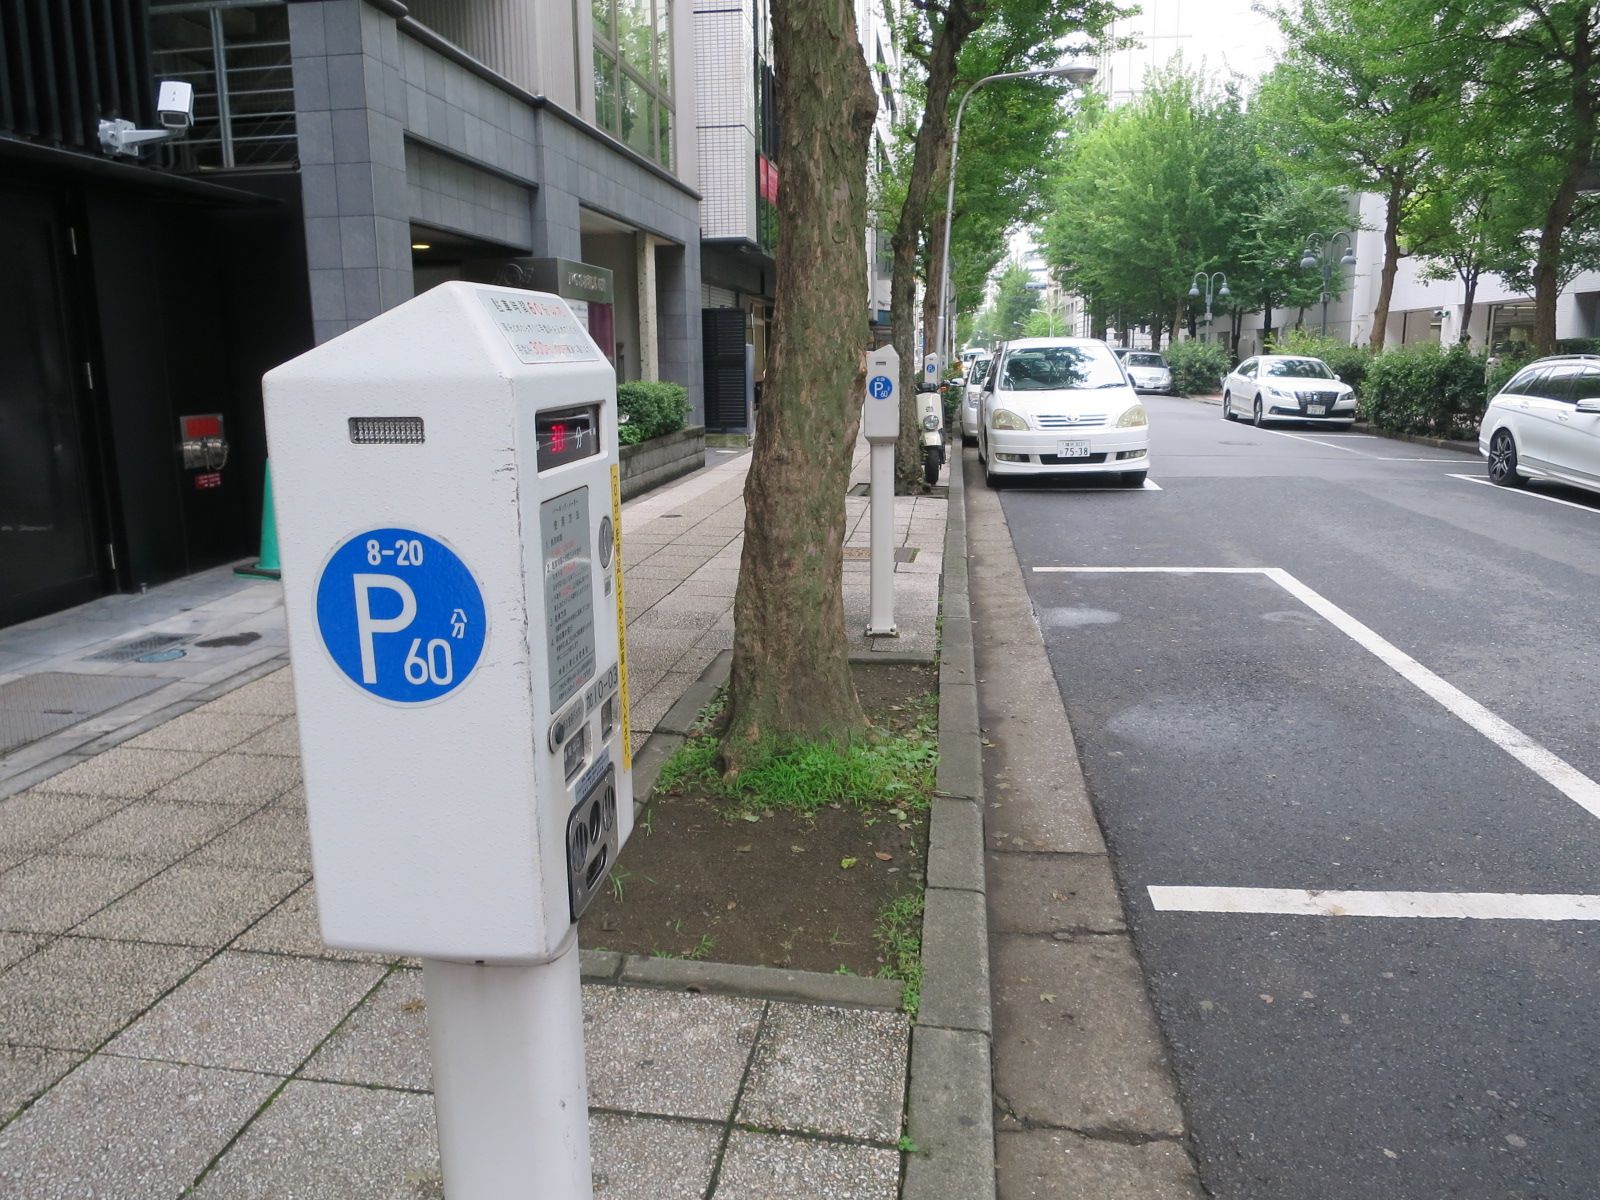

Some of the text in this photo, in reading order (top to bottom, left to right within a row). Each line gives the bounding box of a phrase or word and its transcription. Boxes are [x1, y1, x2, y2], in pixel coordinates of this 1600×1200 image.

[875, 382, 883, 397] P
[551, 425, 565, 453] 30
[1064, 447, 1088, 456] 75-38
[366, 539, 424, 567] 8-20
[353, 573, 468, 686] P 60 分
